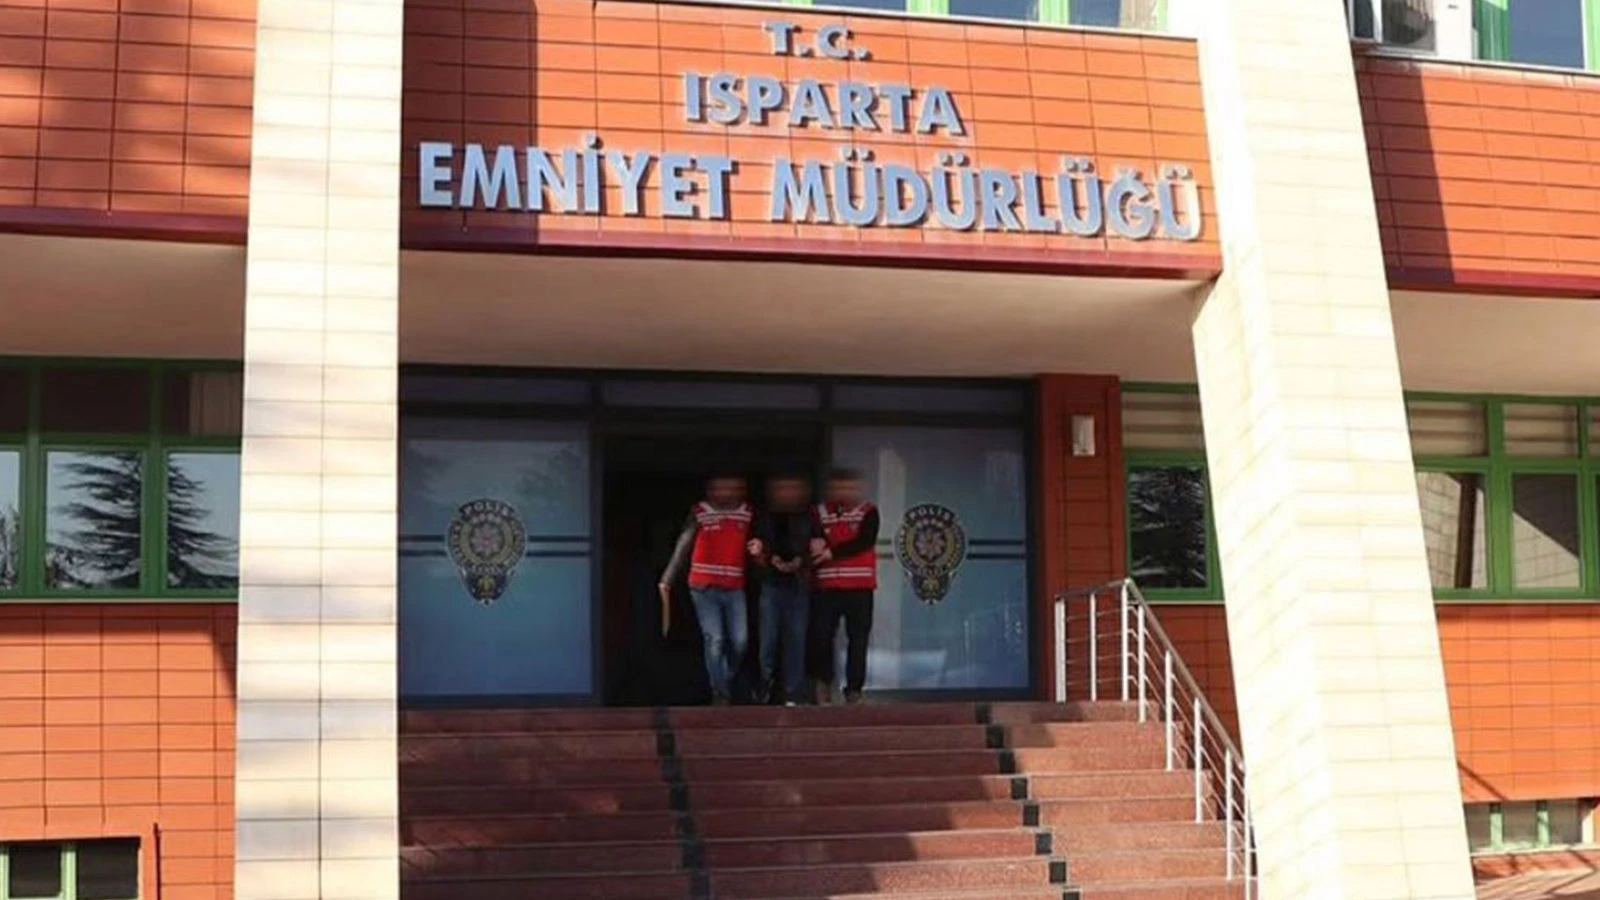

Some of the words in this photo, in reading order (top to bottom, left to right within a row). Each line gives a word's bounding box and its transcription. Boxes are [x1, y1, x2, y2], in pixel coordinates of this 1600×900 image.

[765, 22, 871, 59] T.C.
[685, 73, 966, 136] ISPARTA
[419, 133, 736, 219] EMNİYET
[771, 148, 1201, 241] MÜDÜRLÜĞÜ
